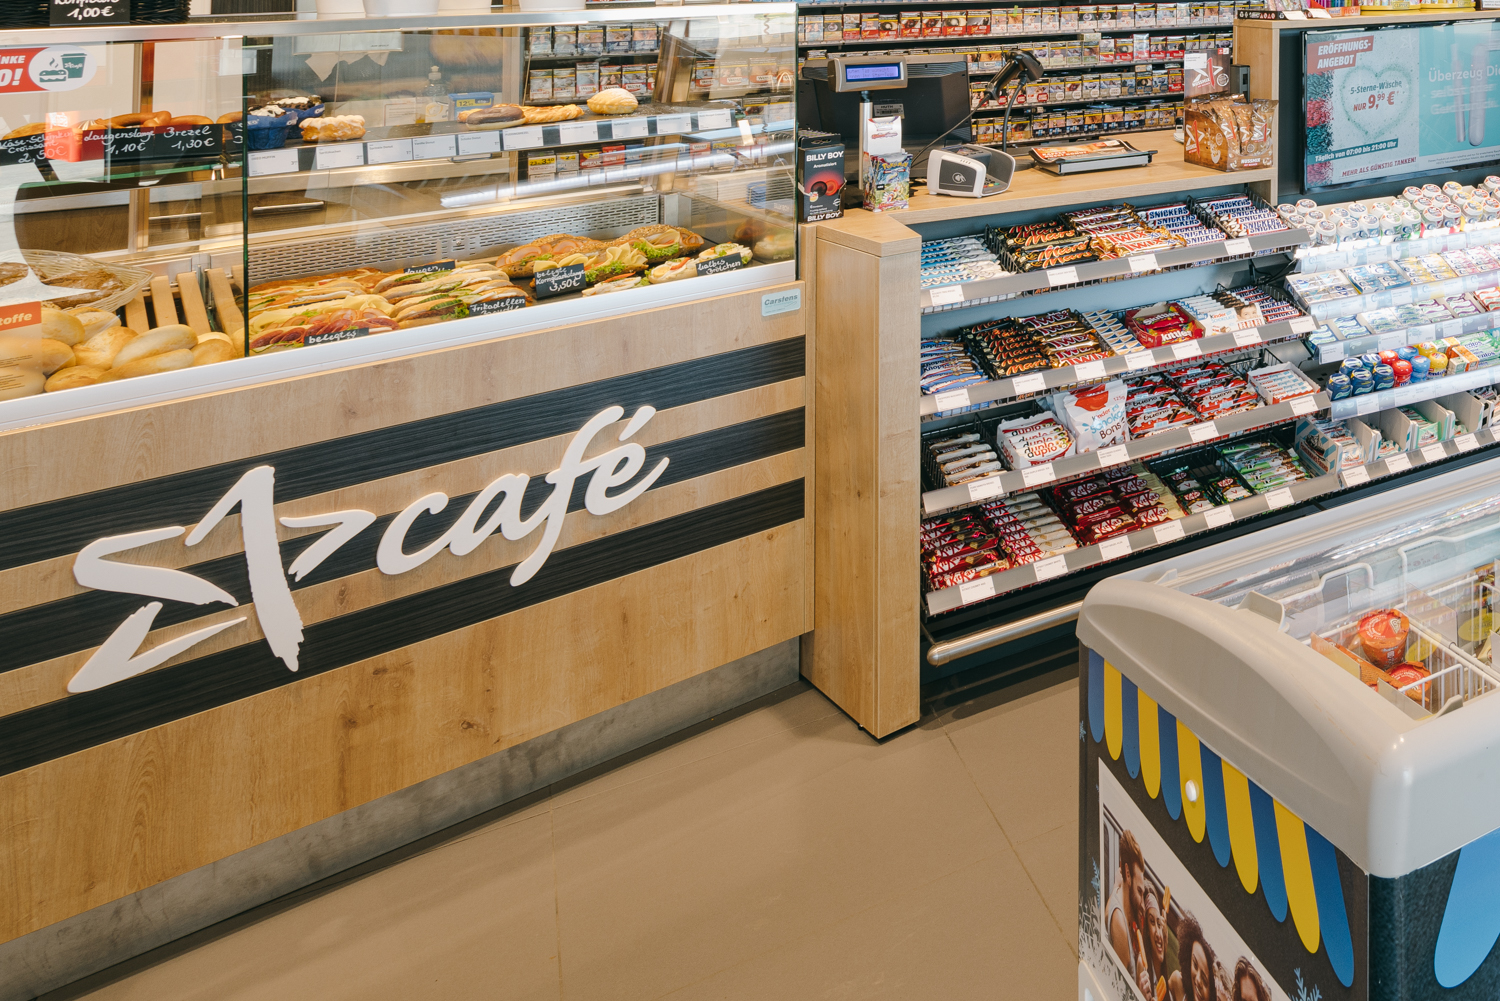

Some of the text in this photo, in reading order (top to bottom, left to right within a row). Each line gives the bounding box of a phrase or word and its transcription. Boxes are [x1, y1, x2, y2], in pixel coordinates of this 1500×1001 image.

[1317, 39, 1371, 56] ERÖFFNUNGS-
[1317, 54, 1355, 69] ANGEBOT
[1428, 67, 1483, 82] Überzeug
[1350, 80, 1402, 94] 5-Sterne-Wäsche
[1353, 103, 1367, 111] NUR
[806, 151, 844, 162] BILLY BOY
[1315, 153, 1333, 162] Täglich
[1362, 146, 1371, 154] bis
[1342, 169, 1355, 177] MEHR
[1370, 161, 1393, 172] GÜNSTIG
[1394, 157, 1417, 167] TANKEN!
[1149, 206, 1190, 219] SNICKERS
[764, 294, 798, 306] Carstens
[1011, 424, 1042, 436] duplo
[1100, 422, 1122, 440] Bons
[376, 405, 670, 587] café
[1070, 484, 1098, 498] KitKat
[1138, 507, 1168, 523] KitKat
[1094, 518, 1123, 534] KitKat
